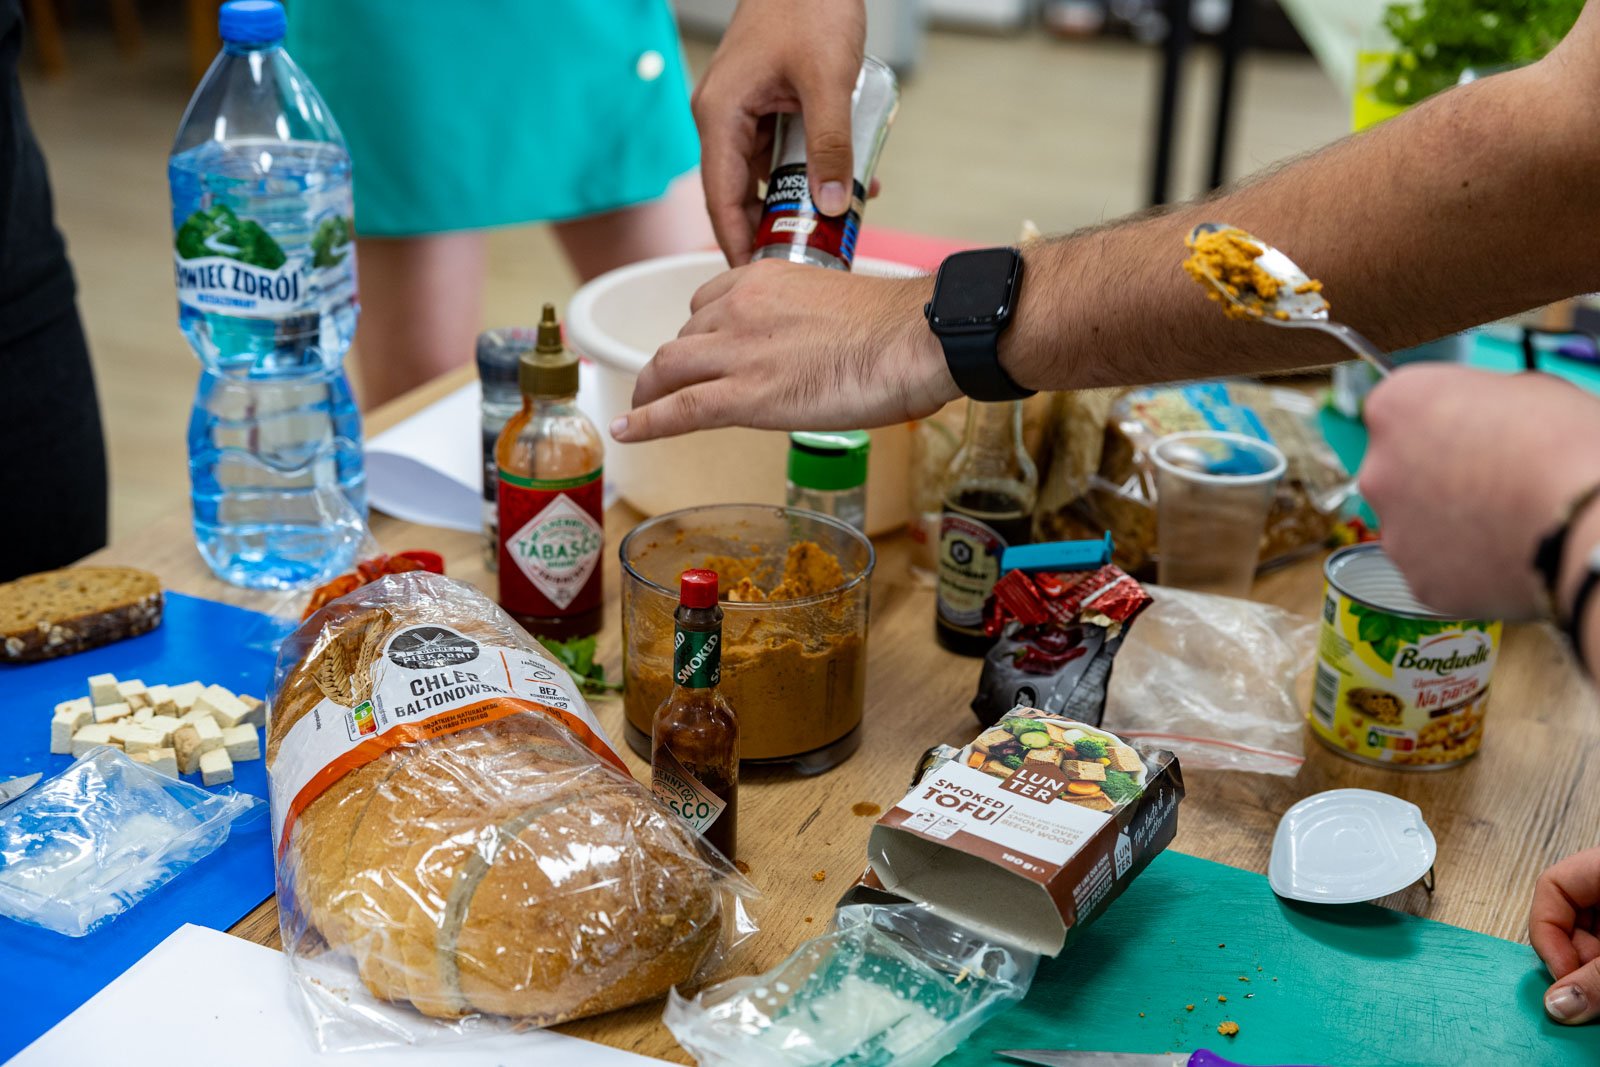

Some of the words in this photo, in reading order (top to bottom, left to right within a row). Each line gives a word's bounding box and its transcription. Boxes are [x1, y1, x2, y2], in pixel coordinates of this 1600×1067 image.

[232, 265, 299, 302] ZDRÓJ
[677, 634, 718, 684] SMOKED
[1398, 643, 1490, 676] Bonduelle
[410, 670, 482, 696] CHLEB
[538, 686, 558, 696] BEZ
[1009, 778, 1052, 801] TER
[1016, 769, 1064, 791] LUN
[922, 786, 997, 820] TOFU
[935, 779, 1005, 809] SMOKED
[1001, 819, 1035, 834] BEECH
[1038, 830, 1074, 846] WOOD
[1008, 814, 1050, 830] SMOKED
[1052, 828, 1080, 840] OVER
[1116, 842, 1130, 863] LUN
[1117, 856, 1131, 875] TER
